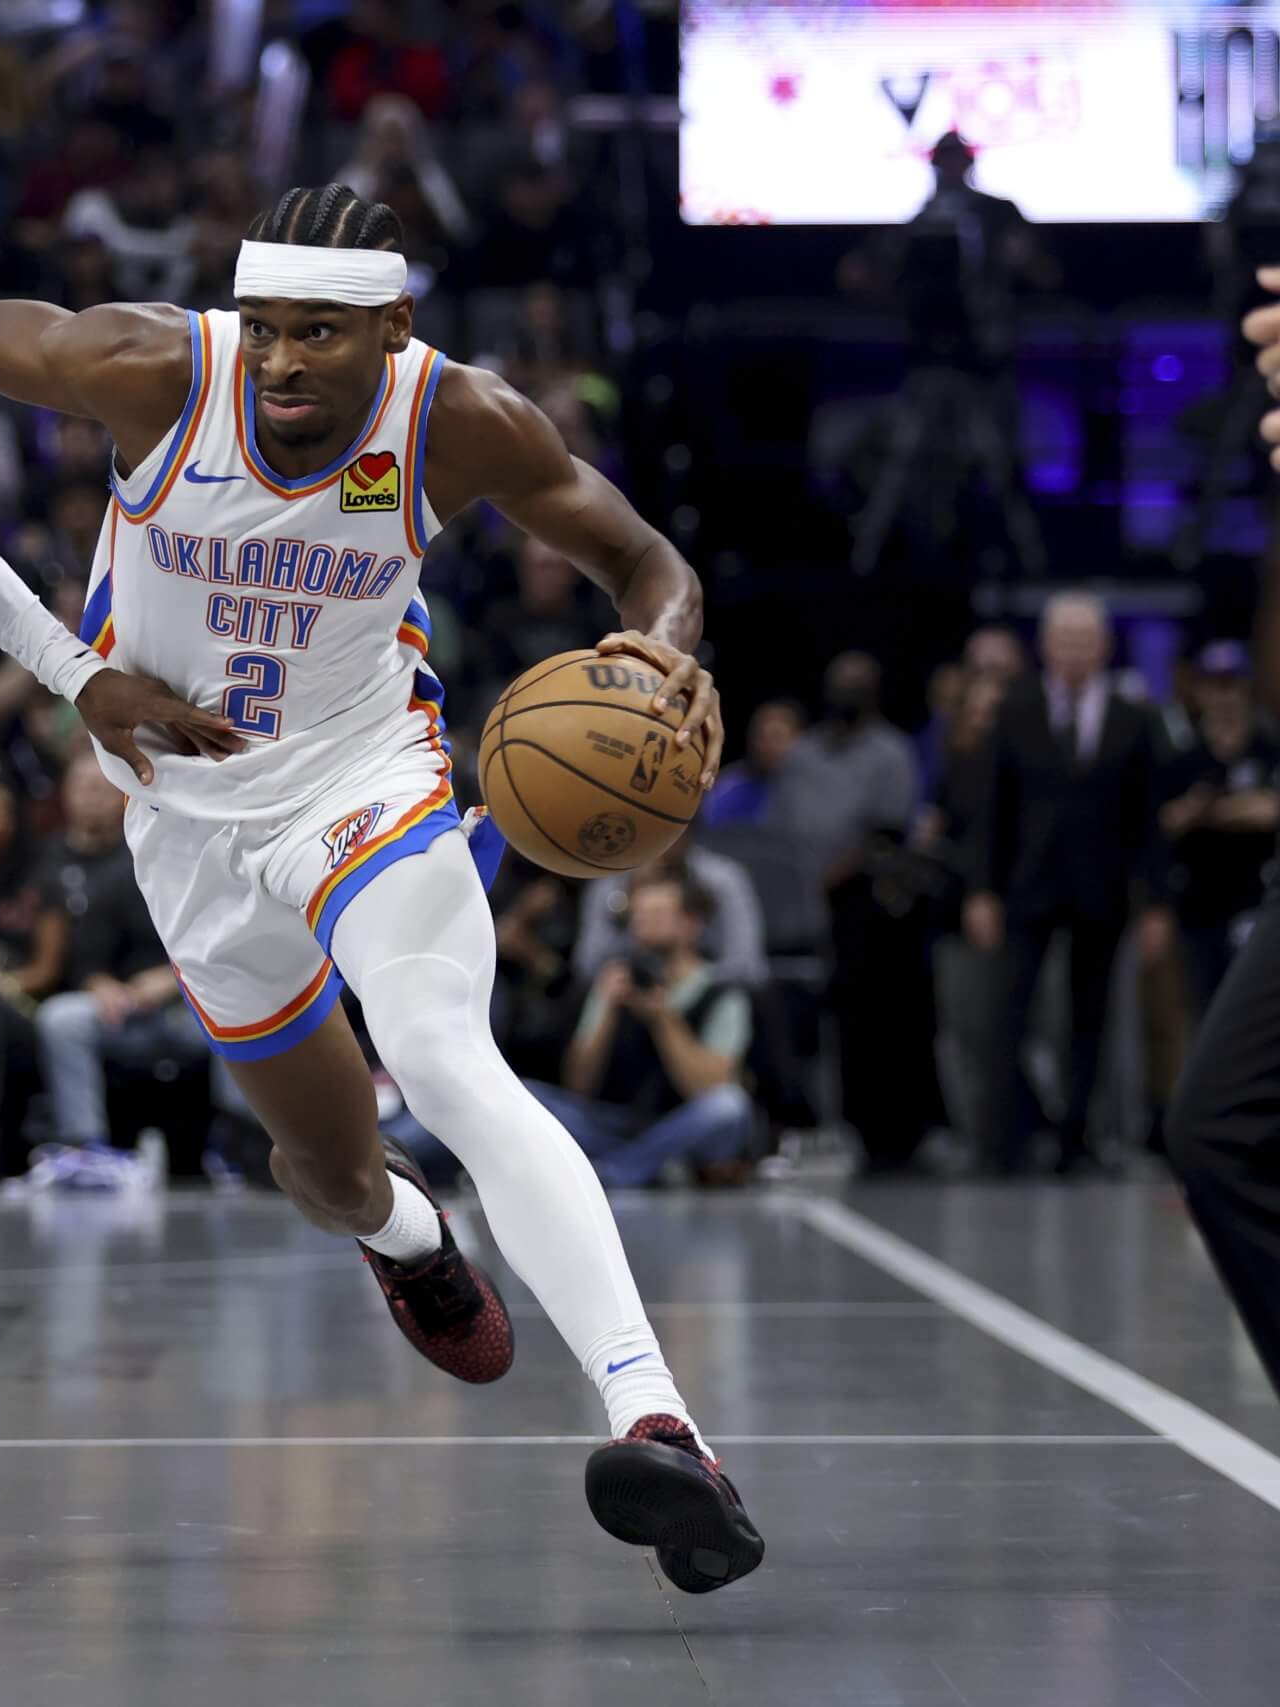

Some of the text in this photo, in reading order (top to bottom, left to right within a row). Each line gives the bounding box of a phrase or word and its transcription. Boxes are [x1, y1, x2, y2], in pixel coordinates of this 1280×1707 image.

[146, 522, 406, 600] OKLAHOMA
[206, 592, 323, 649] CITY
[222, 651, 286, 740] 2
